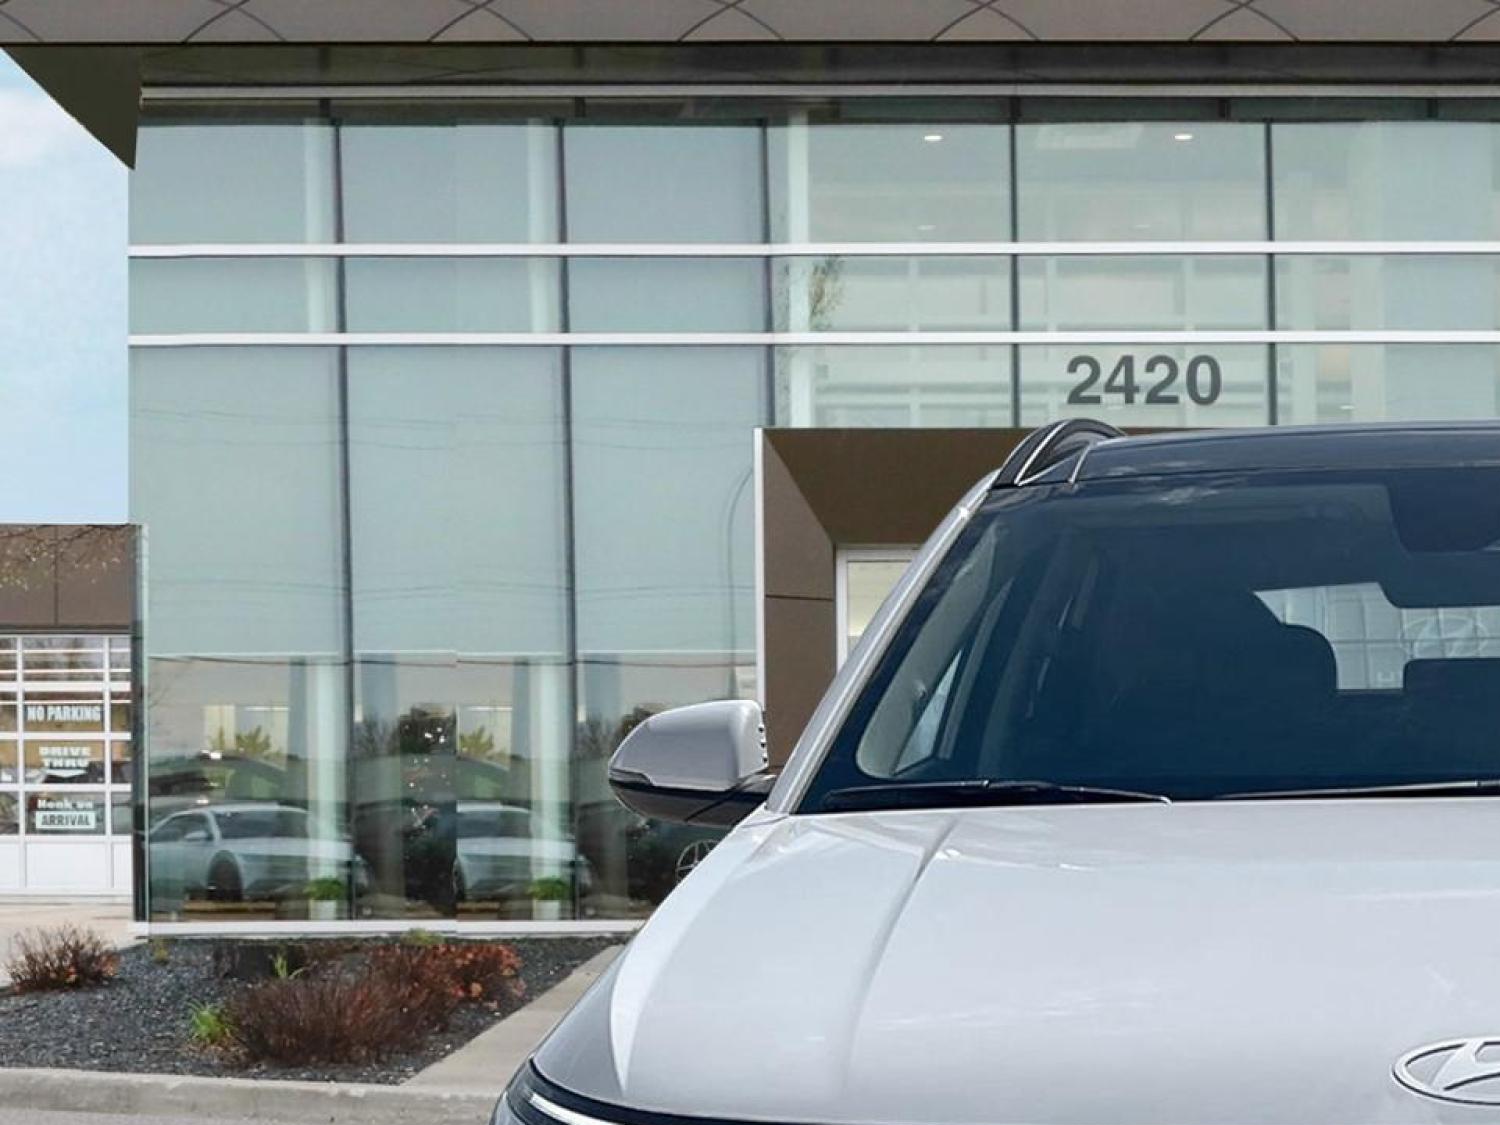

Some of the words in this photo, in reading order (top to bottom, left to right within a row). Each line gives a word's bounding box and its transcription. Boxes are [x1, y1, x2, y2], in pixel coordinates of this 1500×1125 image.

[1067, 355, 1222, 405] 2420
[27, 705, 45, 721] NO
[47, 705, 101, 721] PARKING
[39, 746, 91, 757] DRIVE
[41, 813, 91, 826] ARRIVAL
